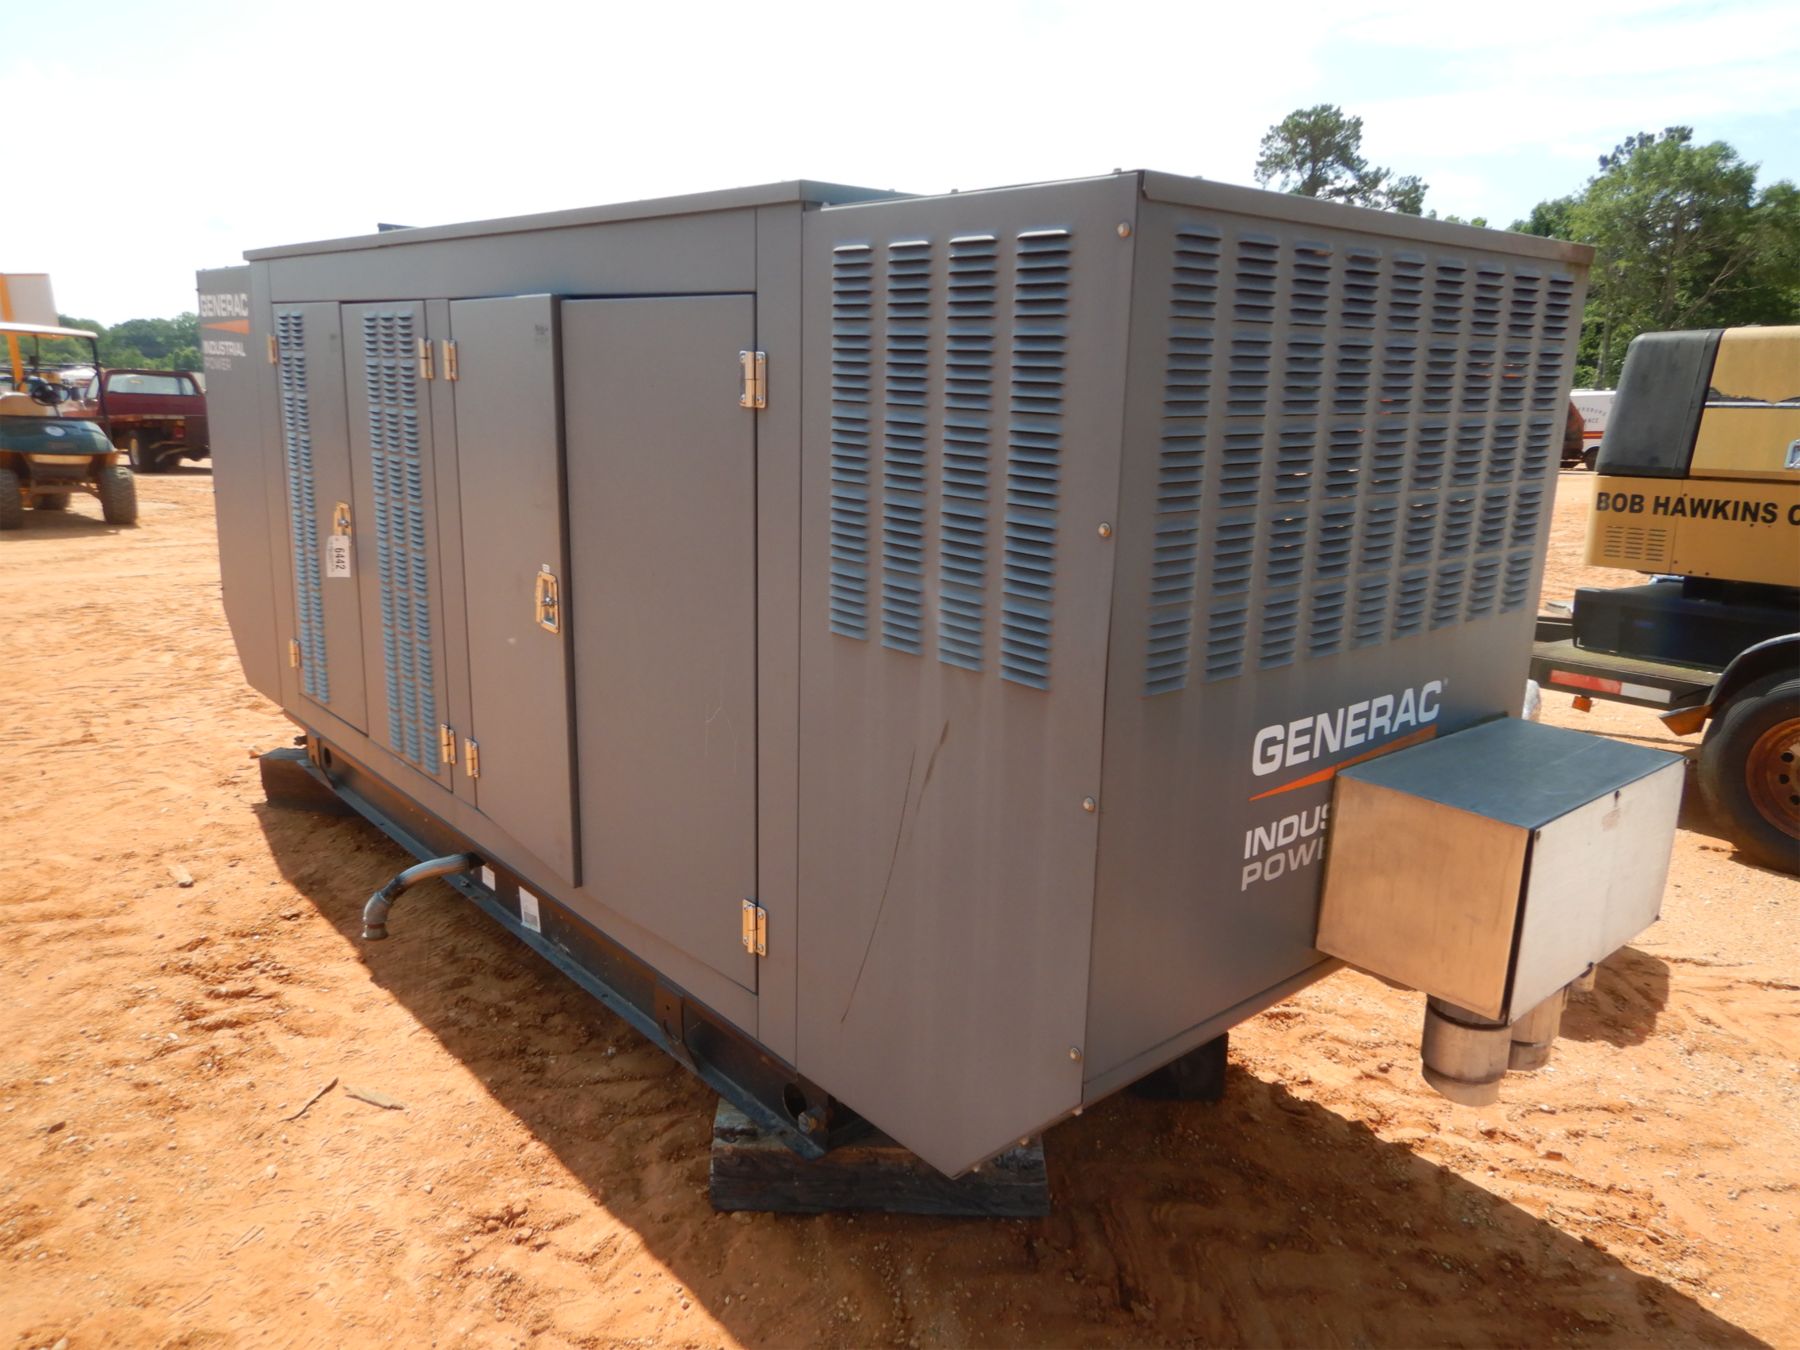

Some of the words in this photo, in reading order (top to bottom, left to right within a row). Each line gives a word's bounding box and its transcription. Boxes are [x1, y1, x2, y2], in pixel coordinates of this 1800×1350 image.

[200, 293, 249, 317] GENERAC
[203, 340, 246, 357] INDUSTRIAL
[1595, 492, 1645, 514] BOB
[1652, 495, 1778, 524] HAWKINS
[334, 547, 346, 570] 6442
[1252, 680, 1442, 777] GENERAC
